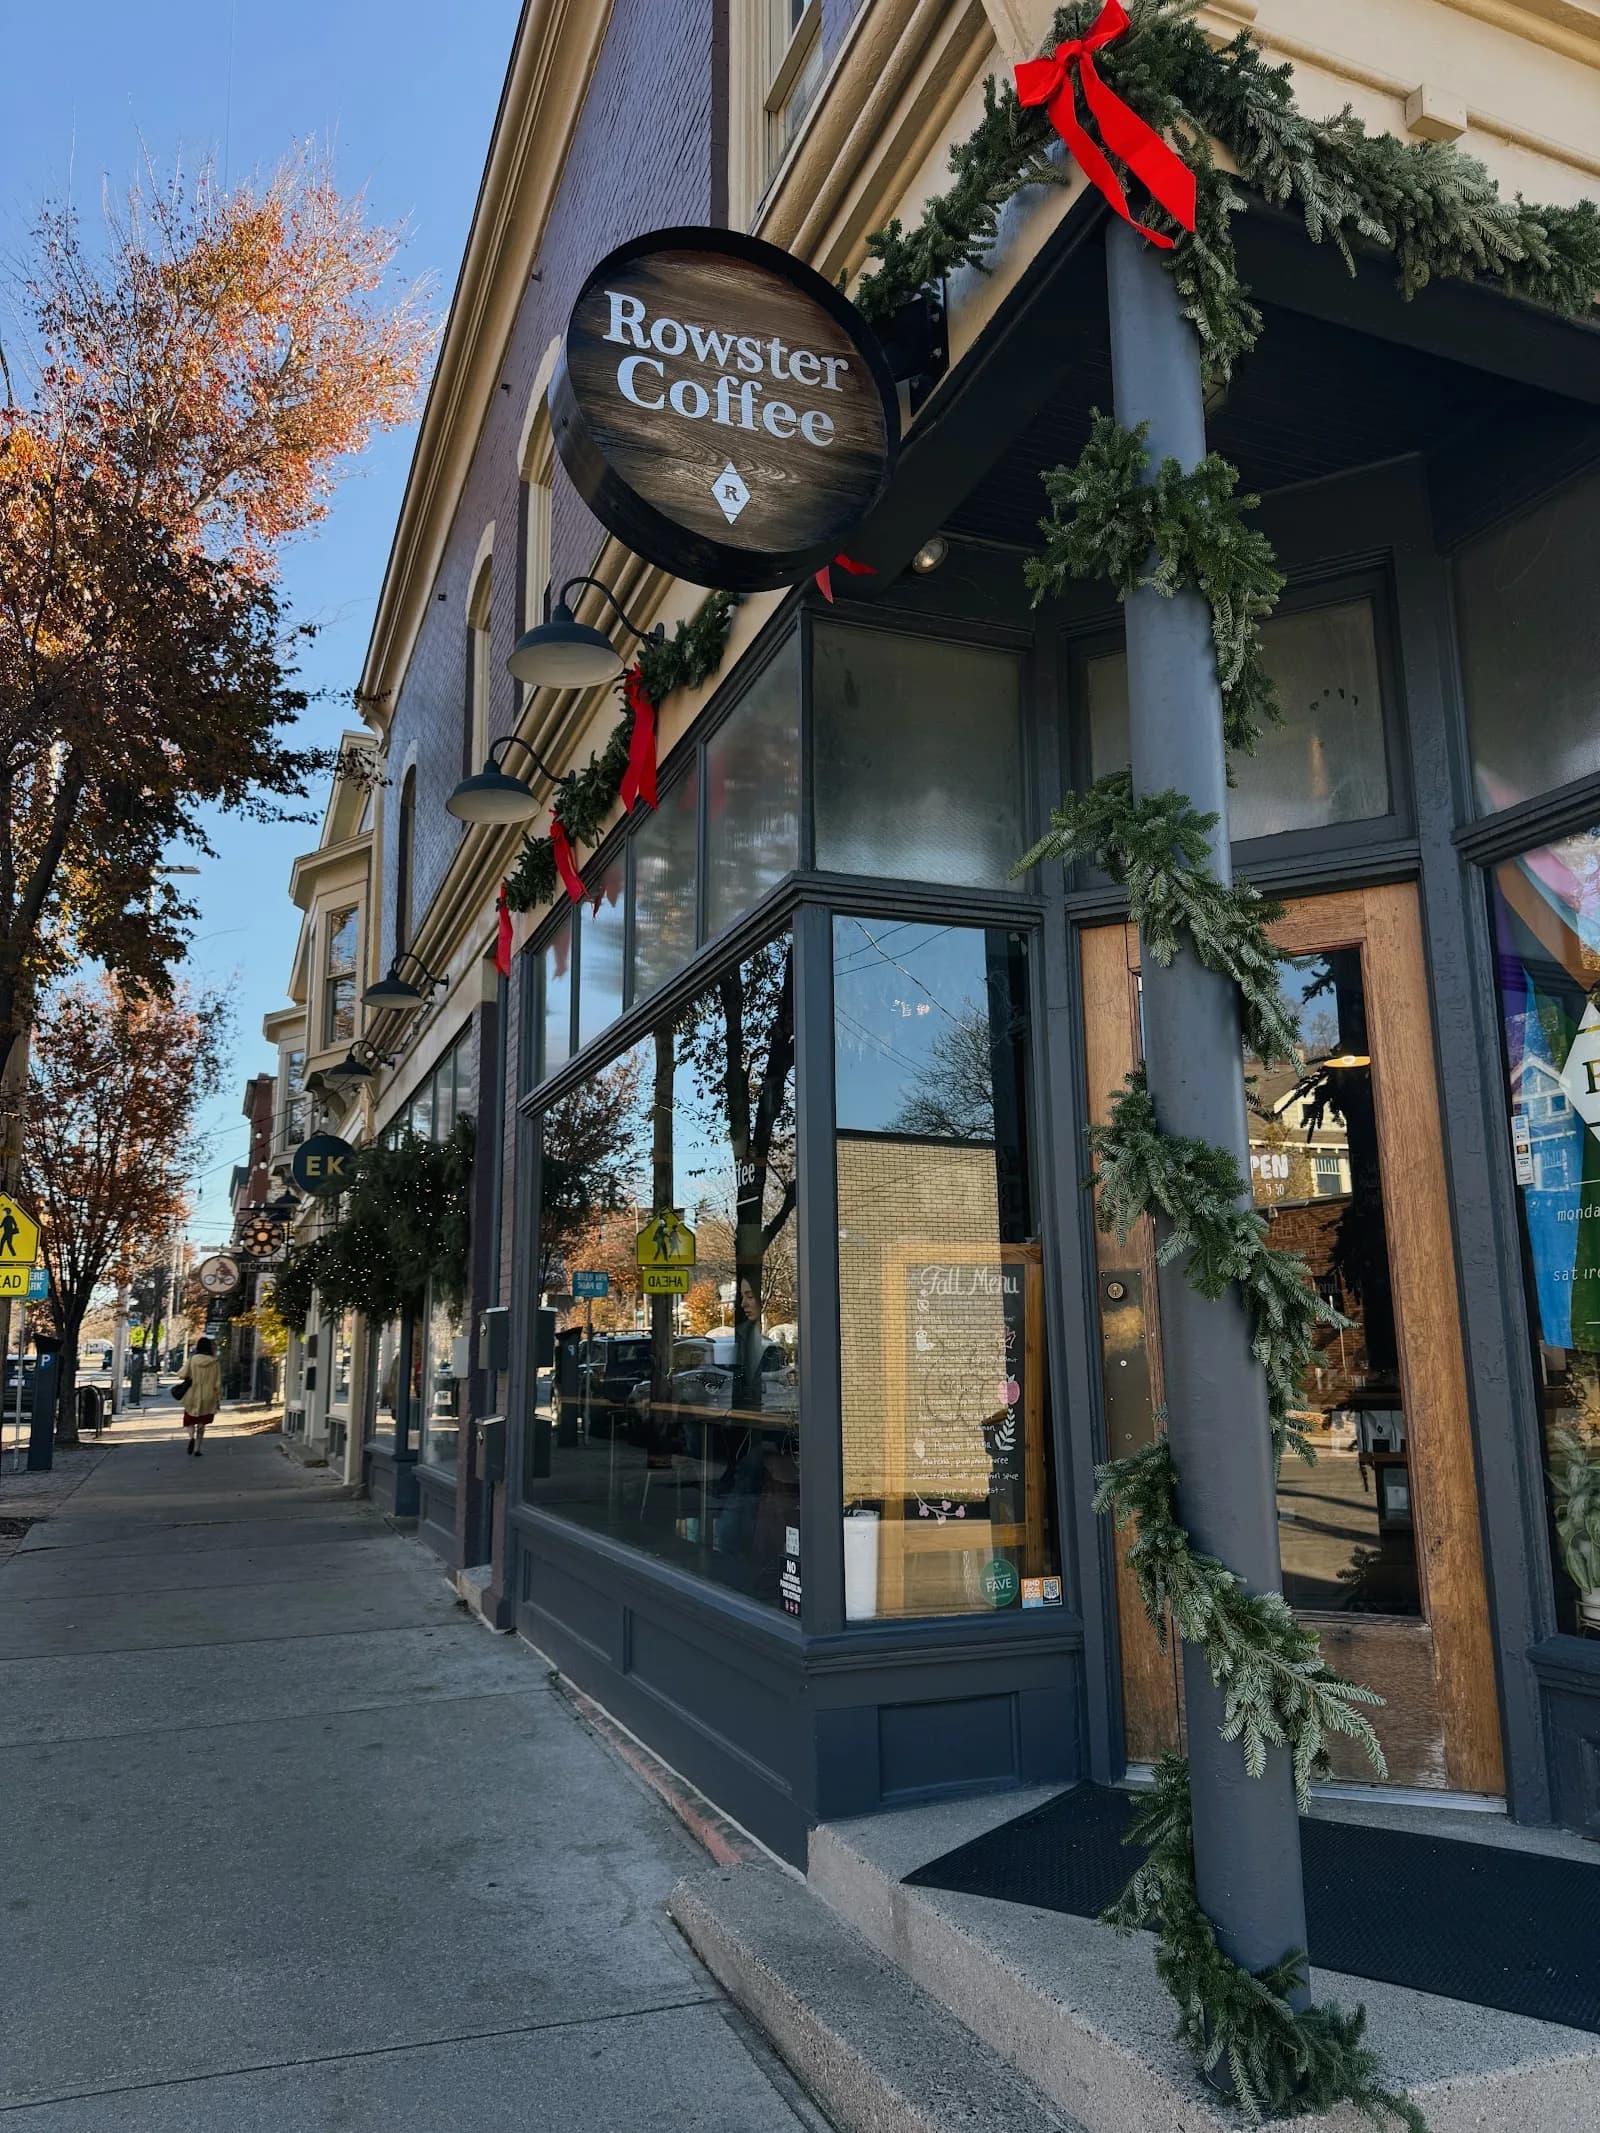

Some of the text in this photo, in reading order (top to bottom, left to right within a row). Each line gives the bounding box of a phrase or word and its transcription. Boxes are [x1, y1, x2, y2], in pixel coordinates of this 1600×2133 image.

[602, 290, 849, 392] Rowster
[616, 355, 835, 447] Coffee
[723, 485, 740, 502] R
[1250, 1154, 1289, 1180] PEN
[0, 1274, 22, 1288] AD
[920, 1265, 1019, 1296] Fall Menu
[41, 1354, 51, 1367] P
[786, 1559, 797, 1574] NO
[986, 1577, 1013, 1593] FAVE
